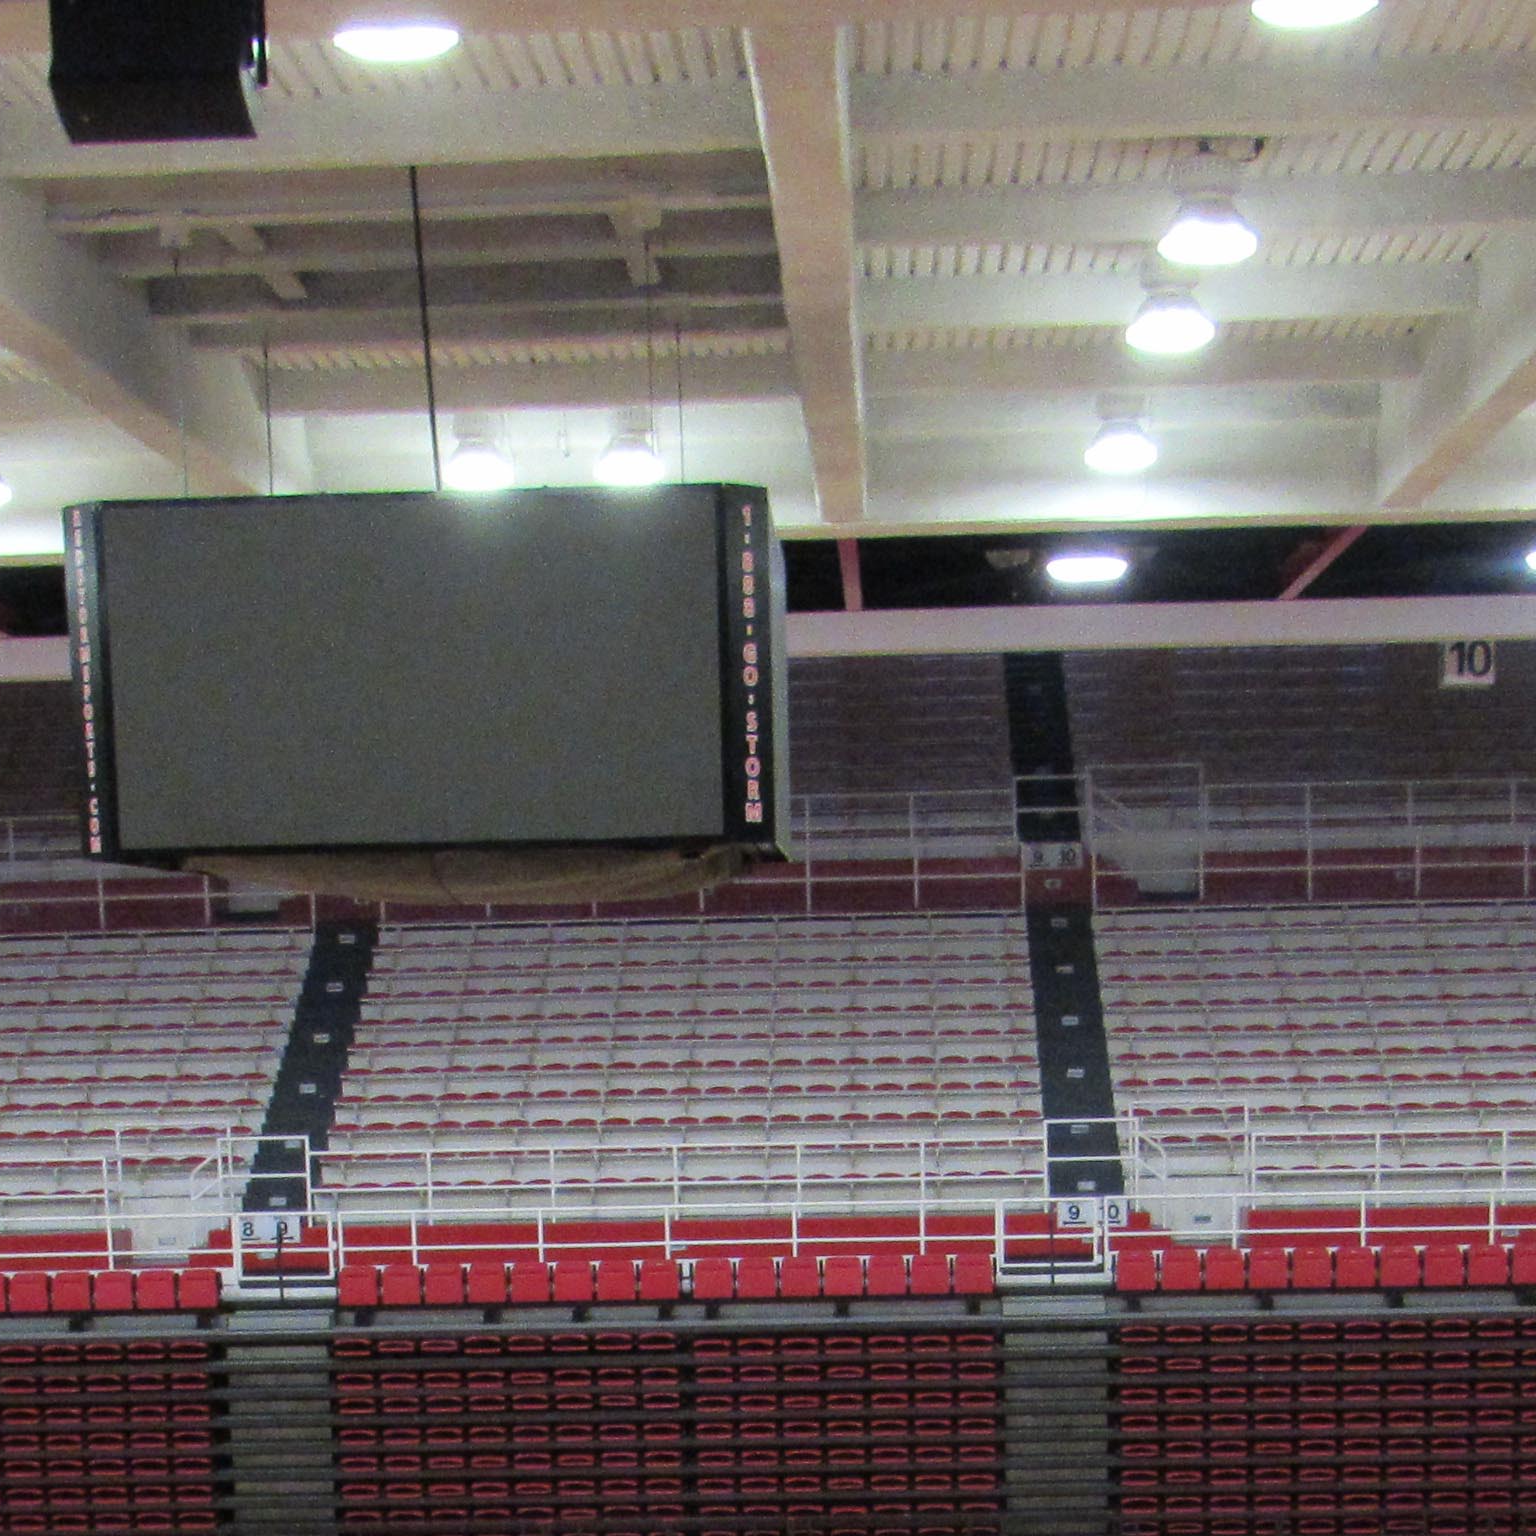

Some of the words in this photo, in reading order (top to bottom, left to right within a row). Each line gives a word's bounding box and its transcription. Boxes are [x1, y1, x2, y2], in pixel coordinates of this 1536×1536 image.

[1450, 641, 1492, 676] 10
[1068, 1204, 1081, 1220] 9
[243, 1221, 255, 1237] 8
